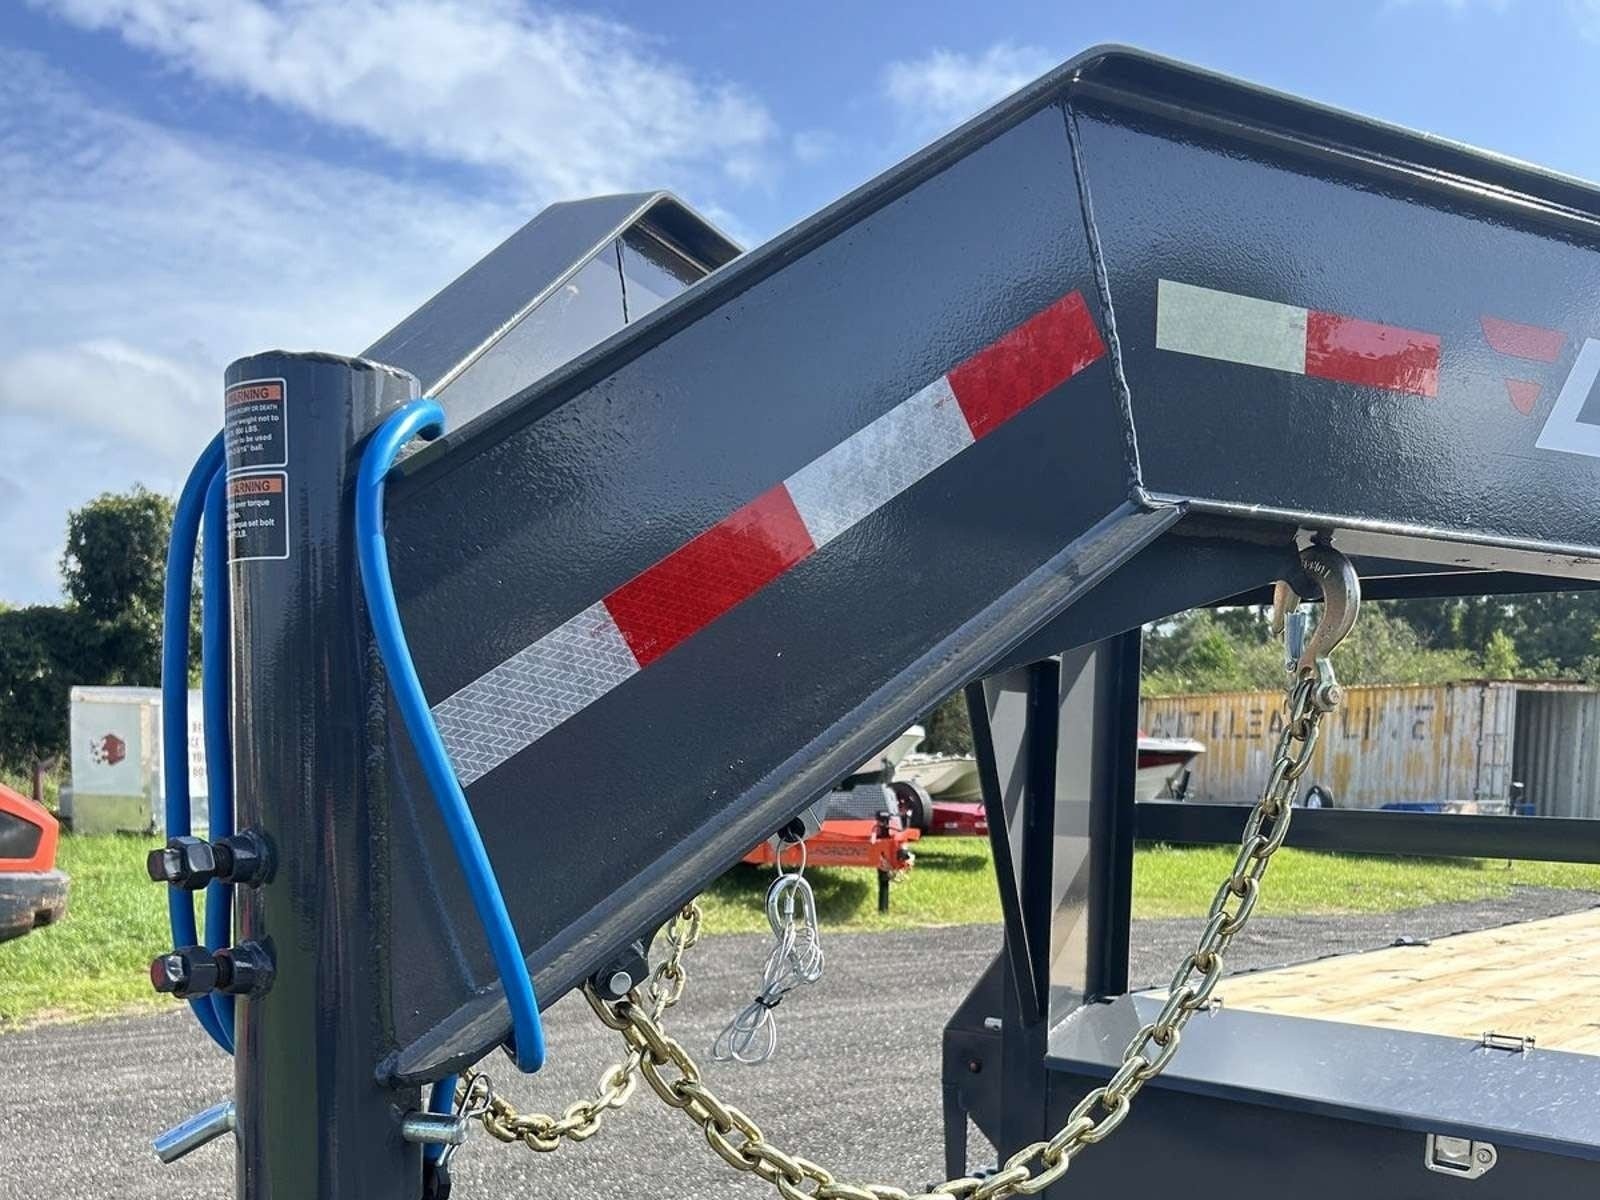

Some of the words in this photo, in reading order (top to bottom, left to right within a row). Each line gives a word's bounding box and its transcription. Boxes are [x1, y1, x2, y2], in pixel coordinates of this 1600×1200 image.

[258, 414, 270, 422] not
[254, 433, 273, 441] used
[247, 499, 271, 507] torque
[248, 519, 259, 527] set
[259, 517, 275, 526] bolt
